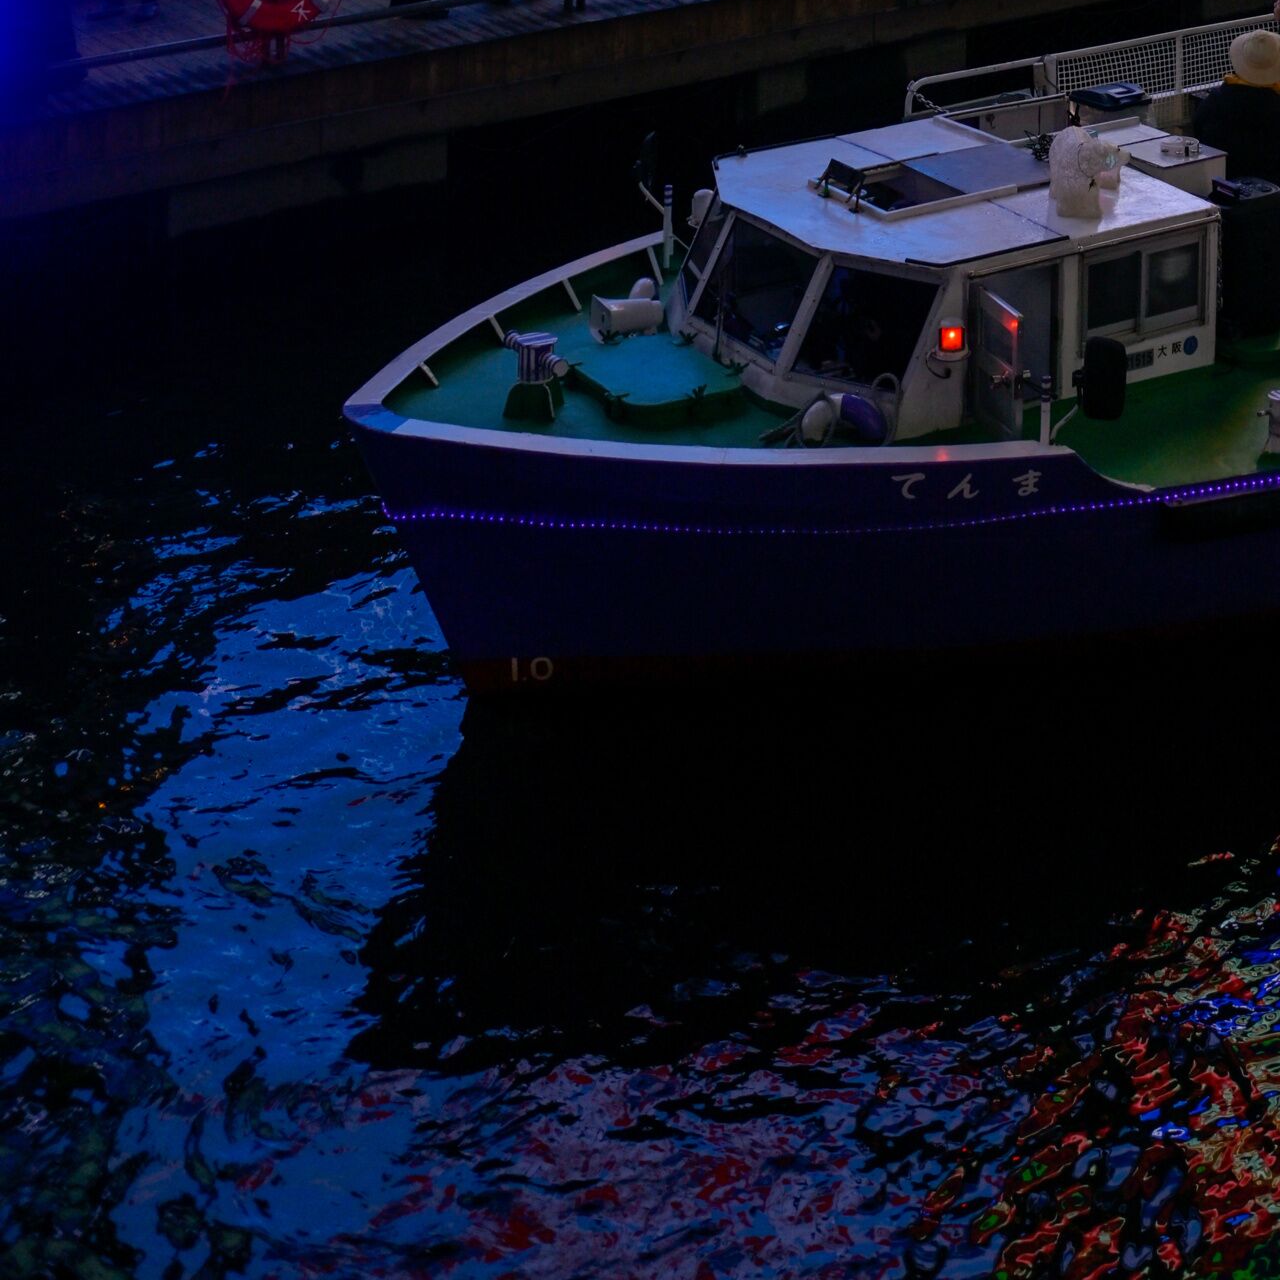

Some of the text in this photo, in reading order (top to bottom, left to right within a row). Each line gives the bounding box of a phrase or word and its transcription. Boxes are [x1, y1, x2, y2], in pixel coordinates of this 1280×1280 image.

[1157, 341, 1182, 359] 大阪
[890, 468, 1042, 500] てんま
